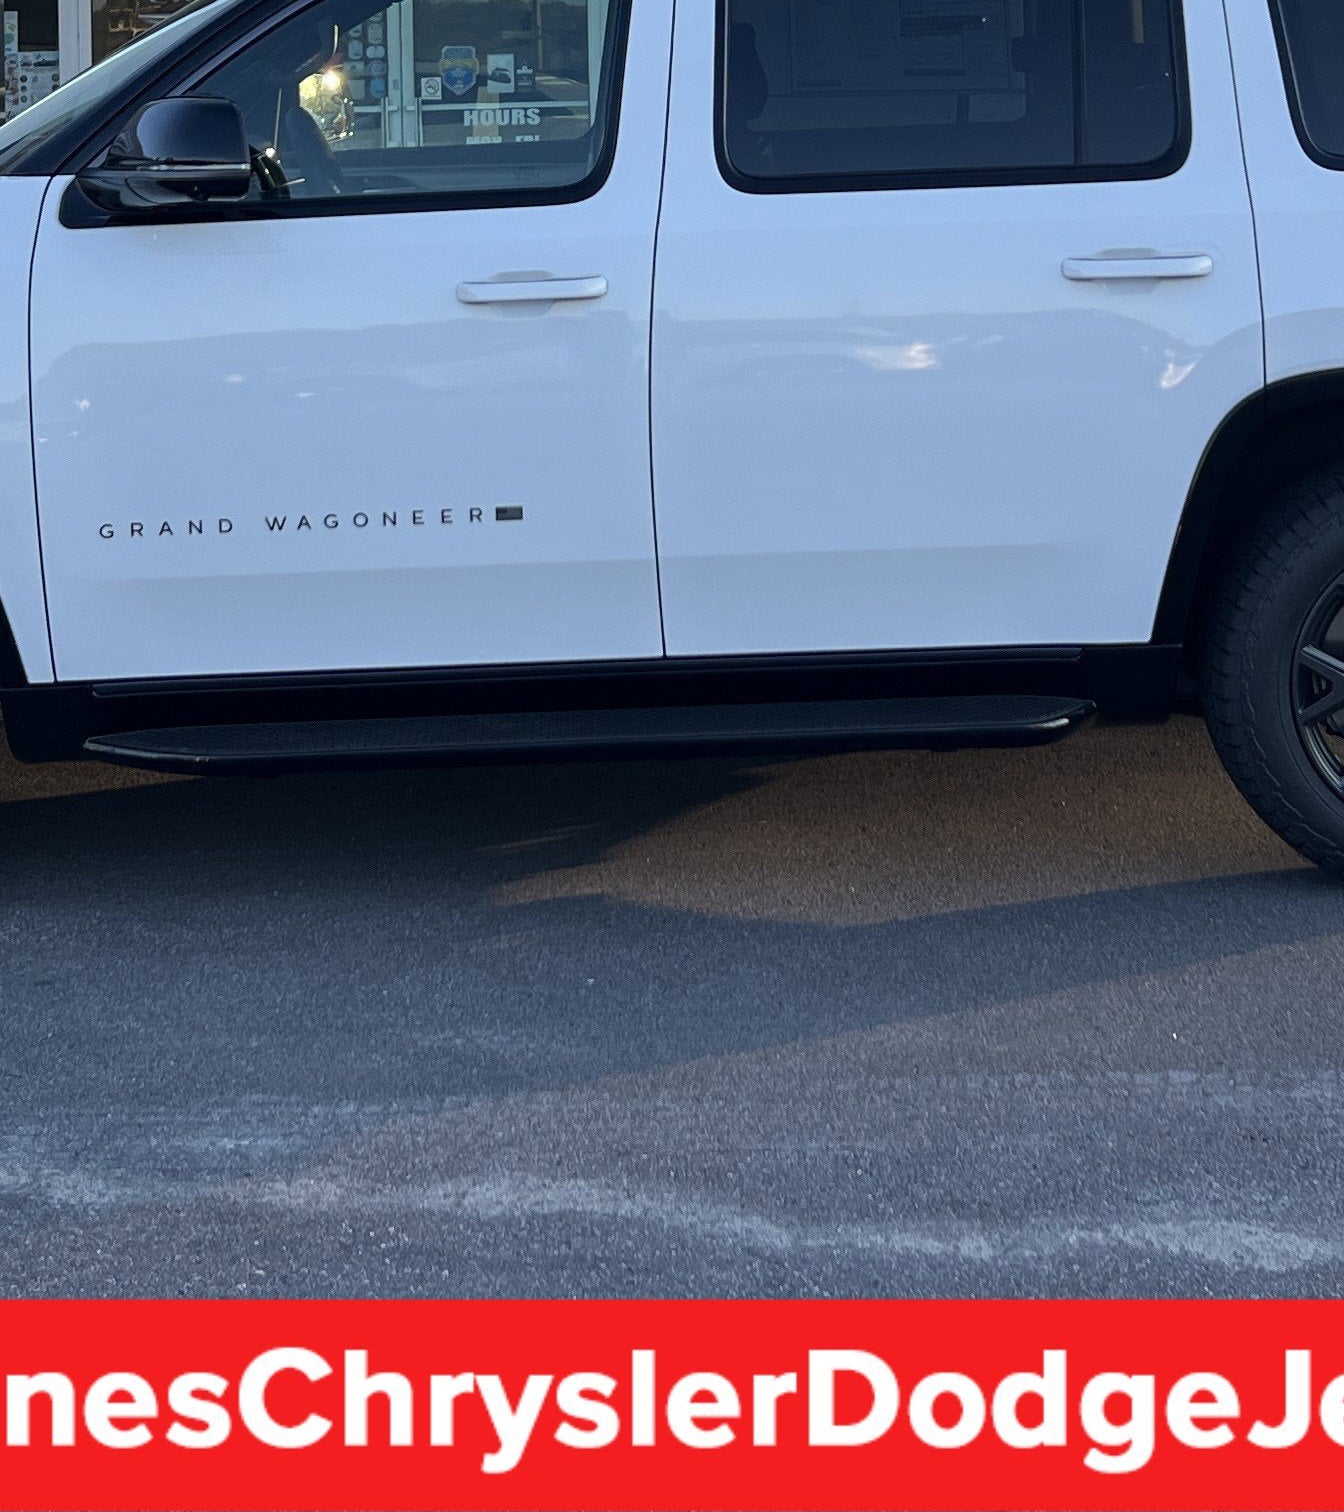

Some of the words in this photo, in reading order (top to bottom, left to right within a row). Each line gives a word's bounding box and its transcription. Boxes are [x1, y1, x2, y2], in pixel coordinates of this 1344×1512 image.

[463, 107, 541, 127] HOURS
[98, 518, 234, 539] GRAND
[265, 508, 484, 532] WAGONEER
